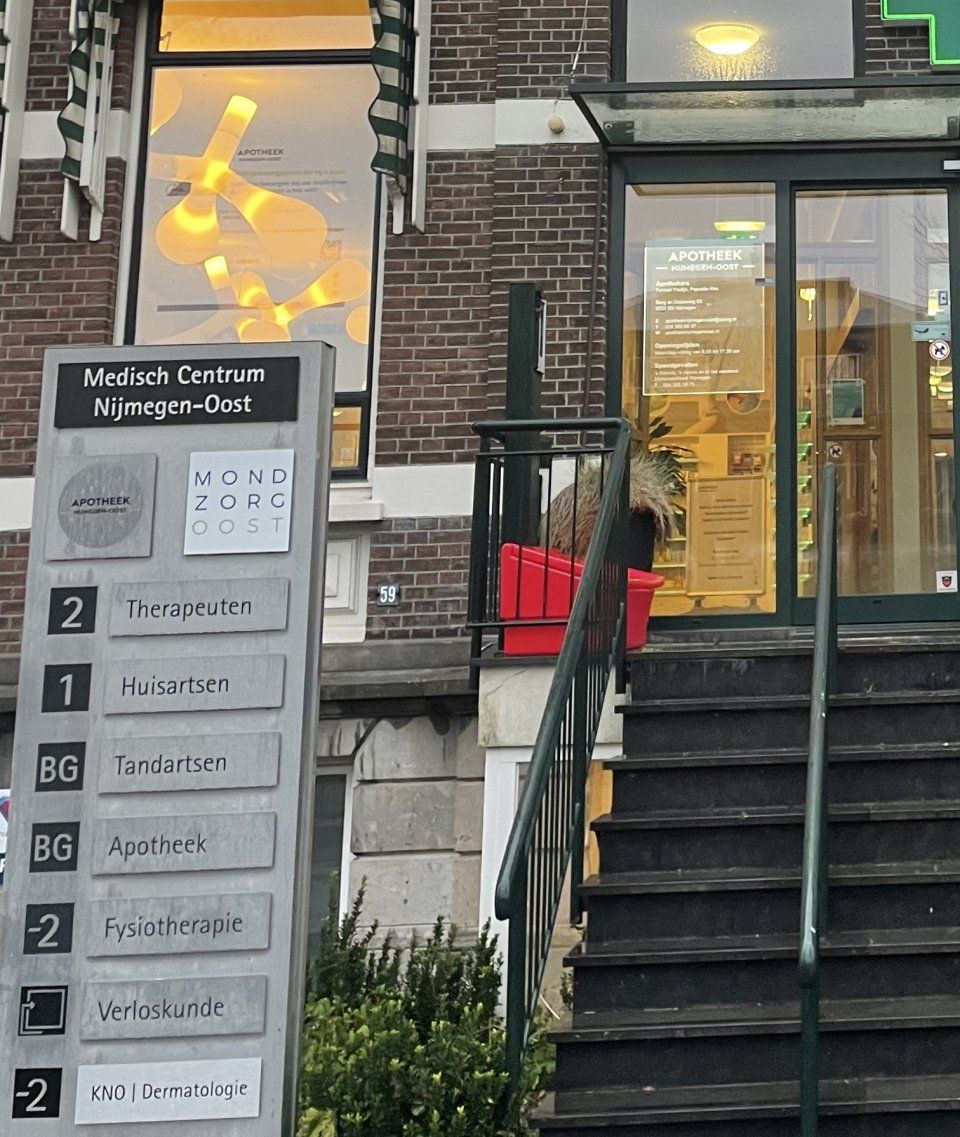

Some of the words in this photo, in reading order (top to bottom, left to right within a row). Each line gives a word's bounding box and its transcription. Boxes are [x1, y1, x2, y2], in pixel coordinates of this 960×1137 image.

[237, 148, 285, 156] APOTHEEK
[668, 249, 743, 262] APOTHEEK
[83, 365, 169, 388] Medisch
[177, 365, 265, 385] Centrum
[94, 394, 252, 421] Nijmegen-Oost
[194, 469, 287, 487] MOND
[71, 496, 130, 507] APOTHEEK
[194, 493, 285, 511] ZORG
[191, 517, 284, 536] OOST
[380, 585, 397, 603] 59
[61, 596, 84, 628] 2
[126, 598, 252, 622] Therapeuten
[58, 674, 73, 706] 1
[121, 675, 230, 697] Huisartsen
[39, 753, 79, 783] BG
[114, 753, 227, 776] Tandartsen
[34, 833, 73, 862] BG
[108, 834, 207, 861] Apotheek
[28, 913, 60, 948] -2
[104, 912, 243, 943] Fysiotherapie
[98, 997, 225, 1022] Verloskunde
[16, 1078, 48, 1112] -2
[91, 1084, 125, 1102] KNO
[142, 1080, 248, 1102] Dermatologie
